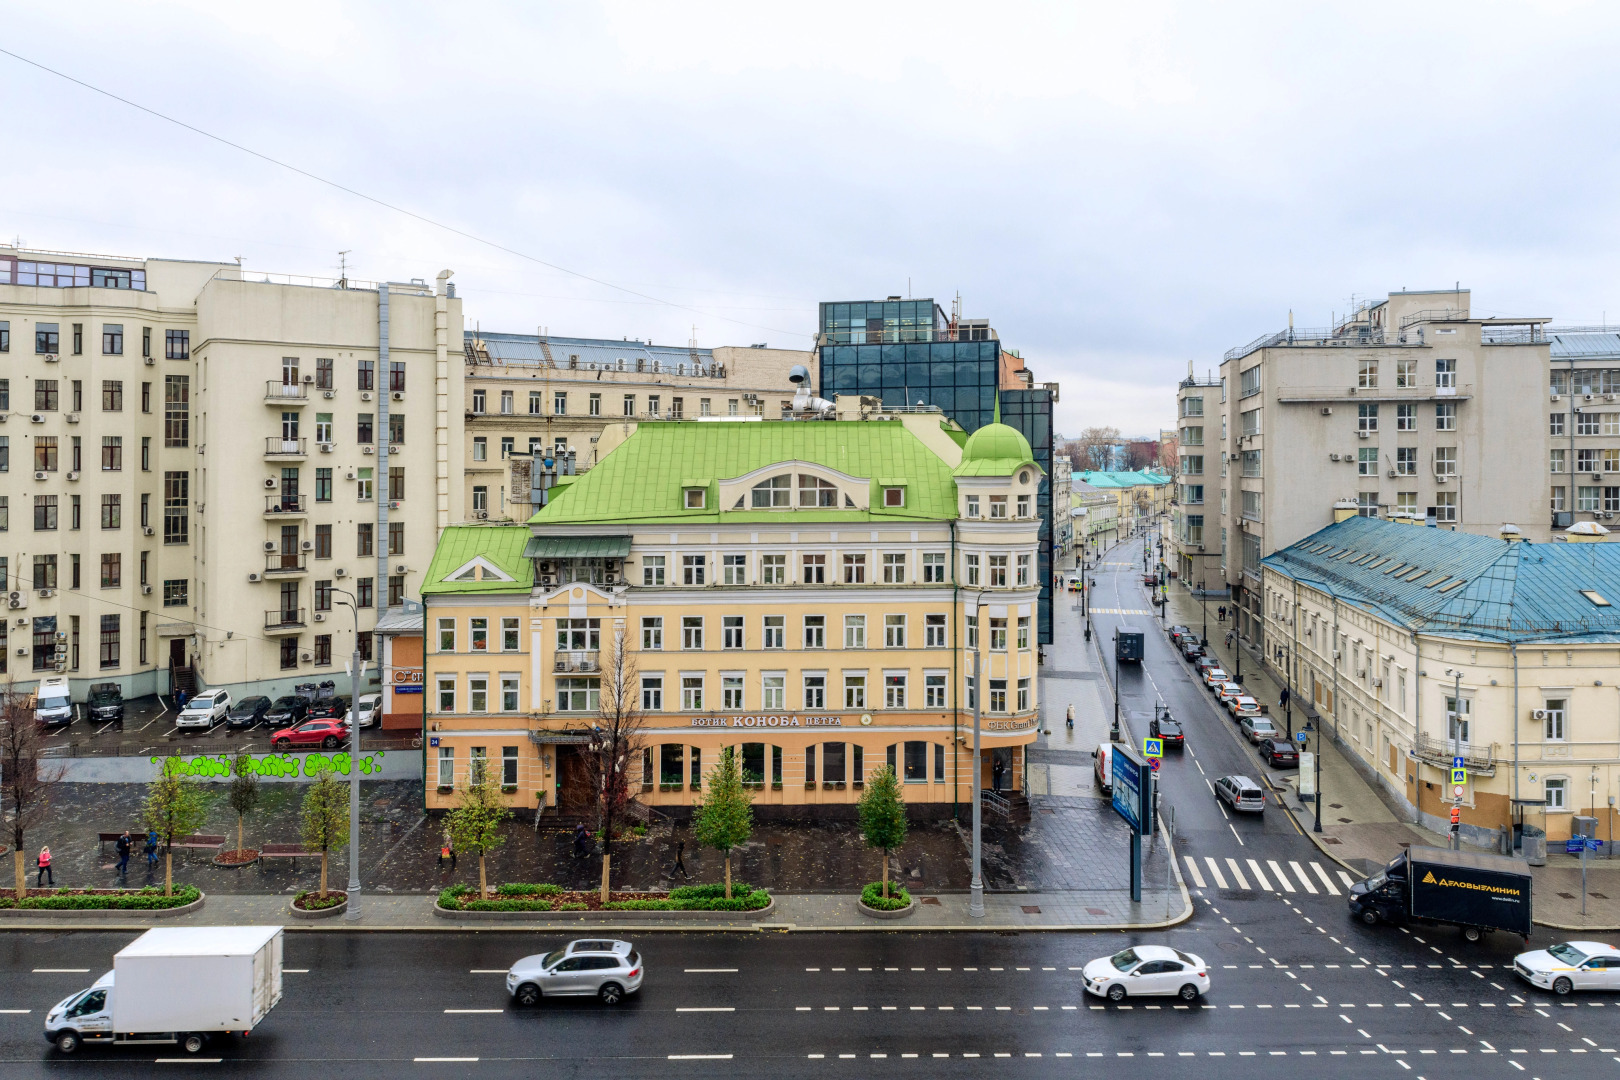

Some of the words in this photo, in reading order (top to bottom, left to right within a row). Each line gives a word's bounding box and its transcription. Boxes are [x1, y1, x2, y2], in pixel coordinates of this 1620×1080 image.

[691, 718, 727, 727] БОТИК
[733, 716, 800, 727] КОНОБА
[805, 717, 842, 726] ПЕТРА
[988, 721, 1009, 730] ФБК
